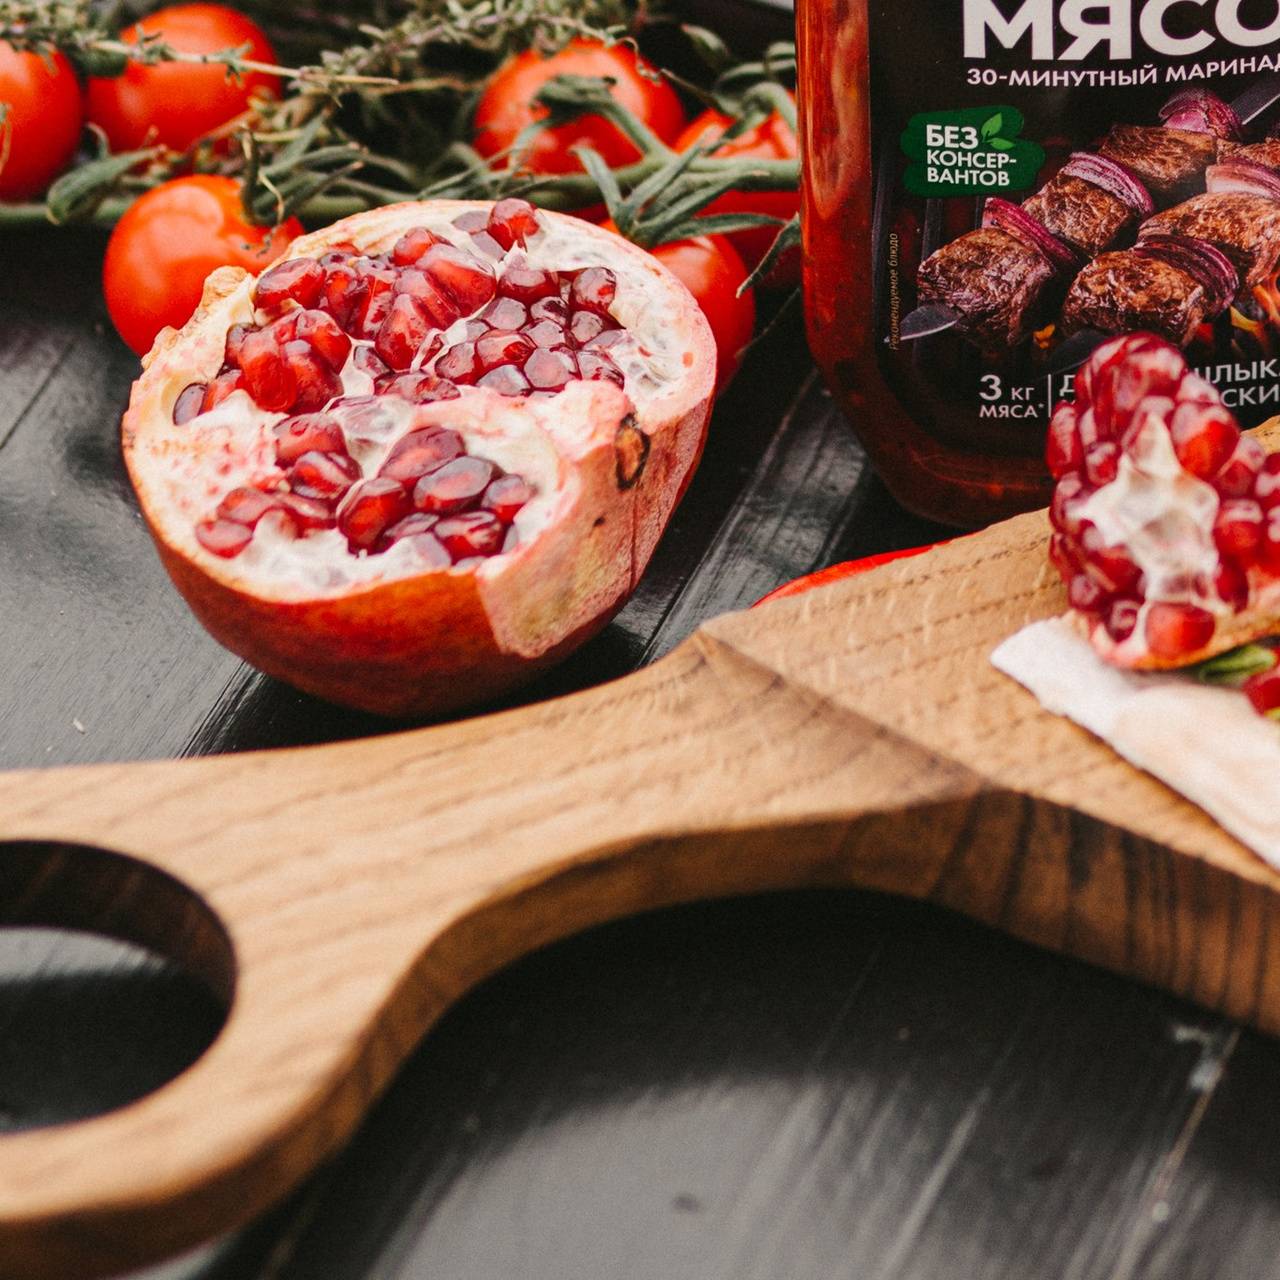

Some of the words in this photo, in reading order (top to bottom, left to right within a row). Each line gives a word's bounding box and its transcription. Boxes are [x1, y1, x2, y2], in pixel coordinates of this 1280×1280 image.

[966, 64, 1158, 88] 30-МИНУТНЫЙ
[926, 124, 979, 150] БЕЗ
[926, 150, 1018, 169] КОНСЕР-
[927, 167, 1011, 187] ВАНТОВ
[887, 232, 899, 266] блюдо
[888, 268, 899, 351] Рекомендуемое
[979, 374, 1003, 401] 3
